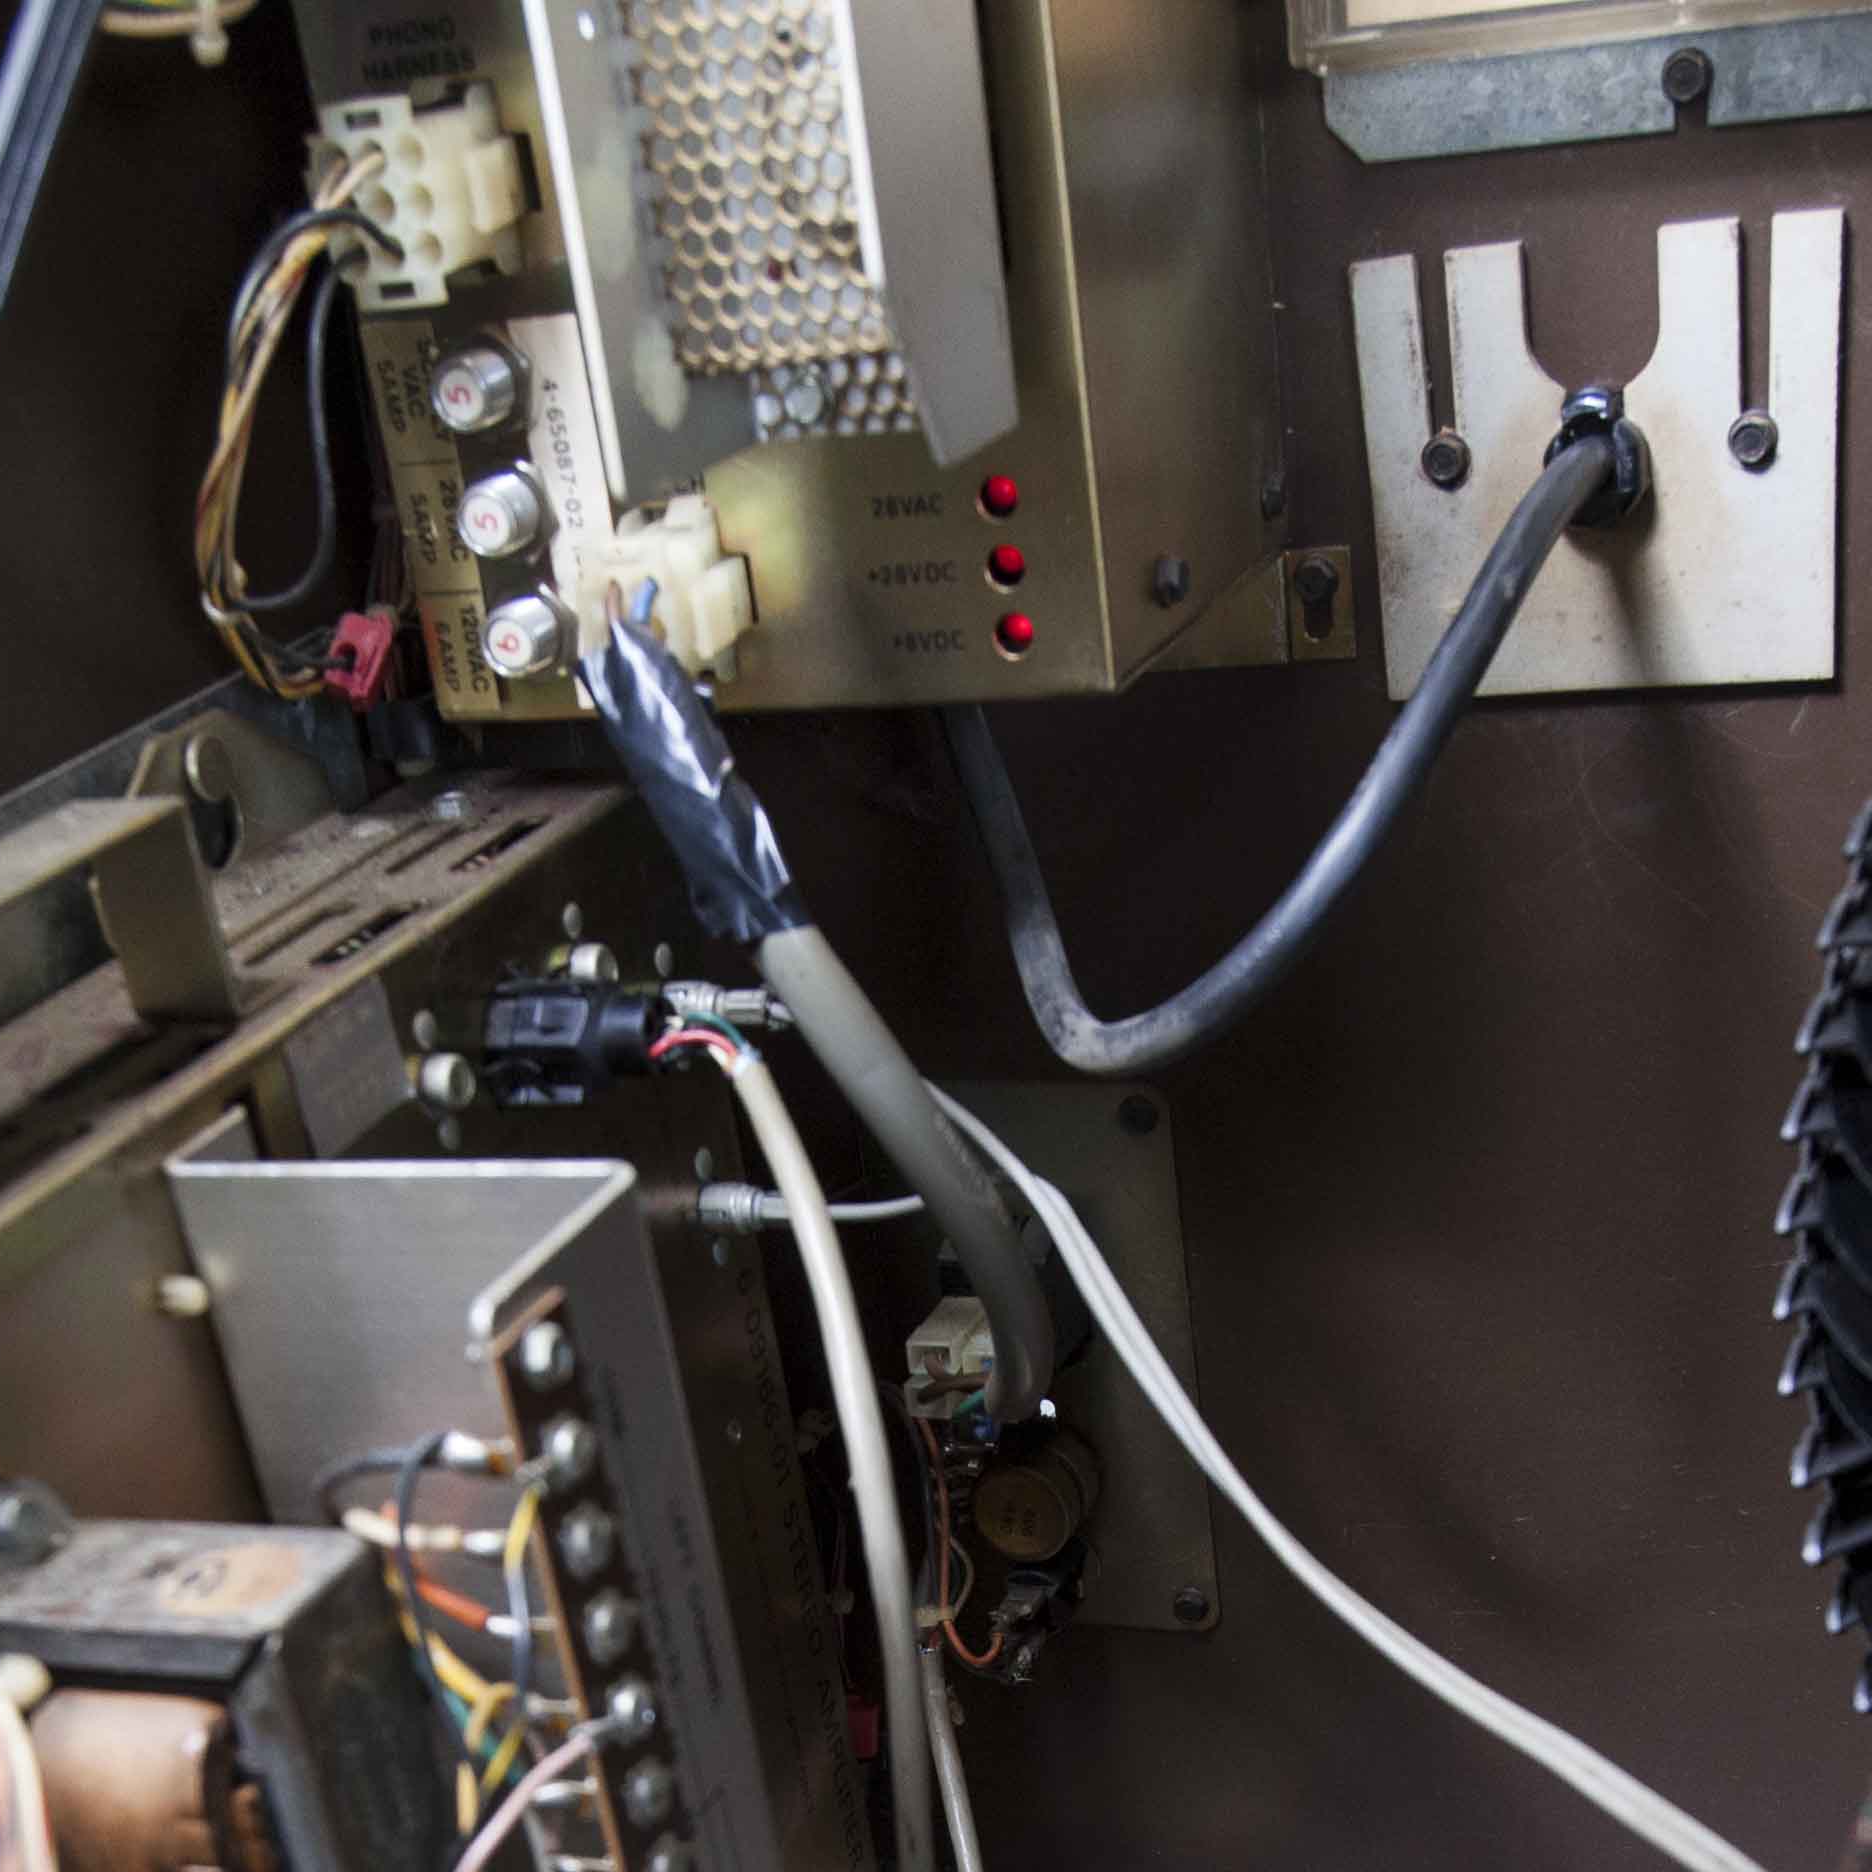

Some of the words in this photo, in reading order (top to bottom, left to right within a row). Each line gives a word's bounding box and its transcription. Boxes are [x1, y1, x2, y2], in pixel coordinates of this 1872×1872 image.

[367, 15, 457, 46] PHONO
[361, 47, 476, 83] HARNESS
[401, 364, 427, 418] VAC
[871, 491, 945, 520] 28VAC
[459, 604, 490, 694] 120VAC
[783, 1499, 823, 1657] STEREO
[815, 1678, 865, 1872] AMPLIFIER
